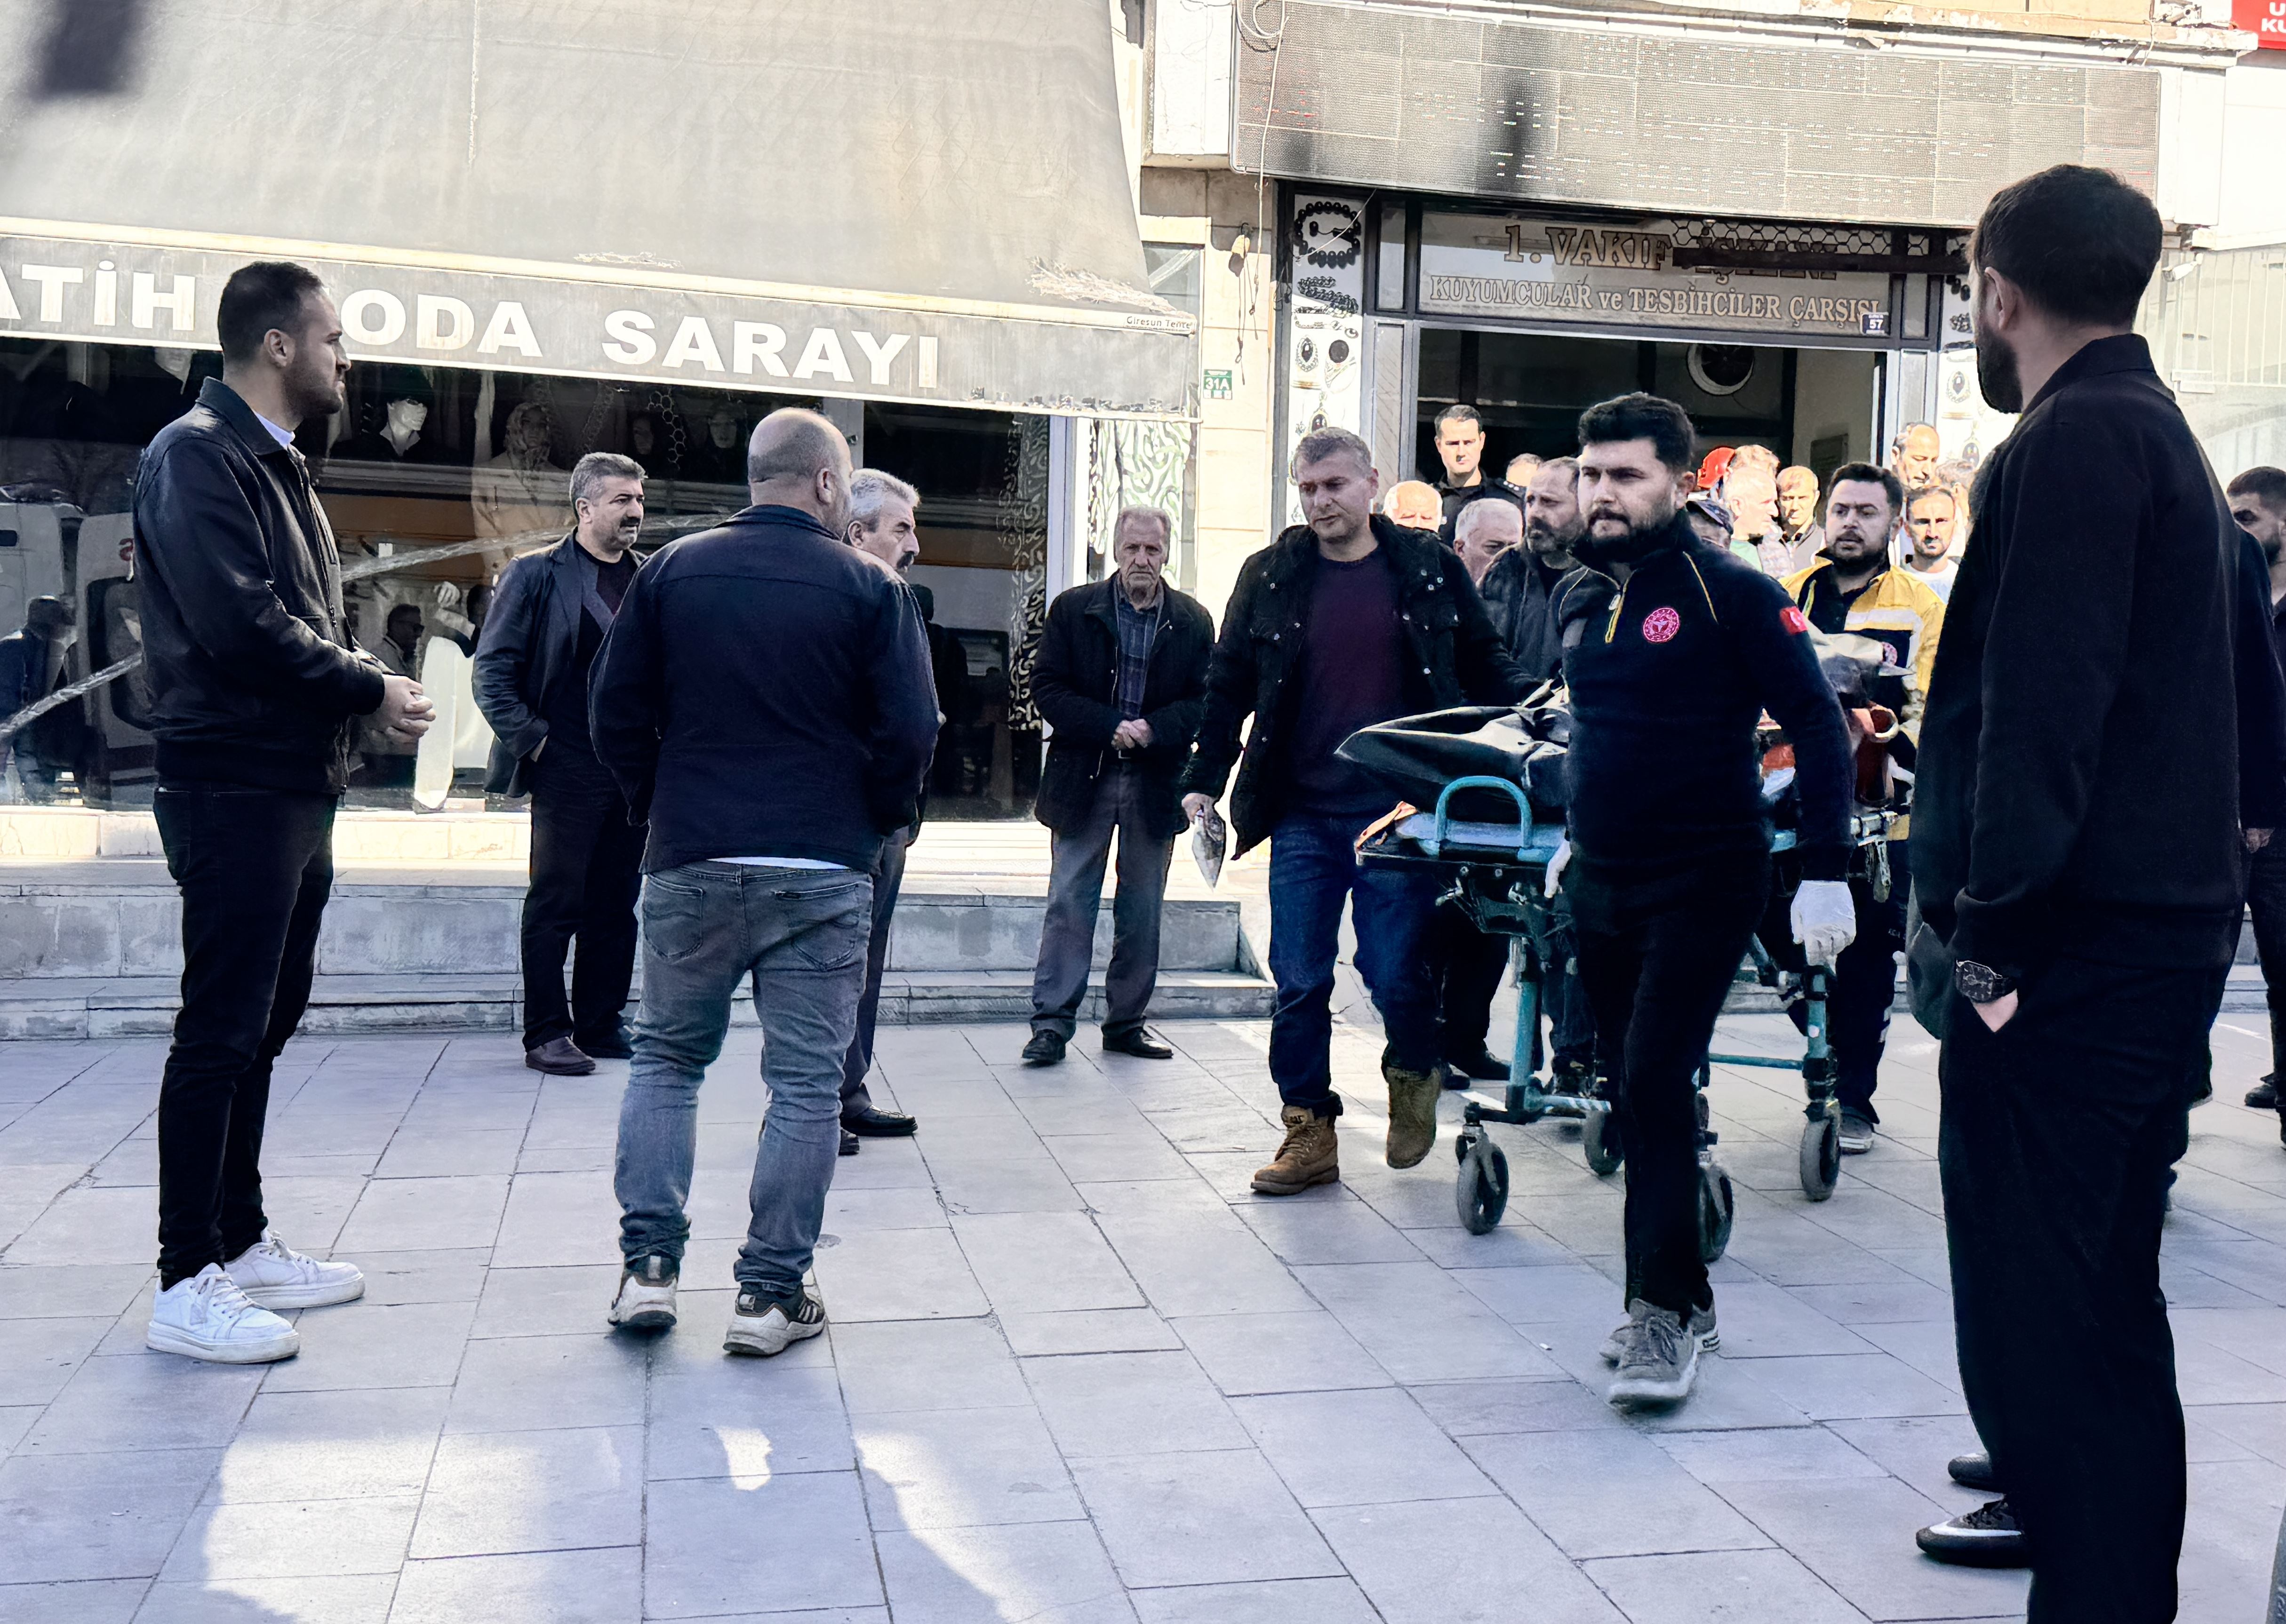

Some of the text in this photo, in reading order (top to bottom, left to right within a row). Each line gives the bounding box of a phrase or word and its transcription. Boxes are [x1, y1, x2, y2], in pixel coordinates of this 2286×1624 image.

[1430, 275, 1593, 309] KUYUMCULAR
[1599, 291, 1623, 311] ve
[1628, 286, 1782, 319] TESBİHCİLER
[322, 287, 543, 358] ODA
[602, 310, 938, 388] SARAYI
[1869, 318, 1884, 329] 57
[1205, 377, 1230, 390] 31A
